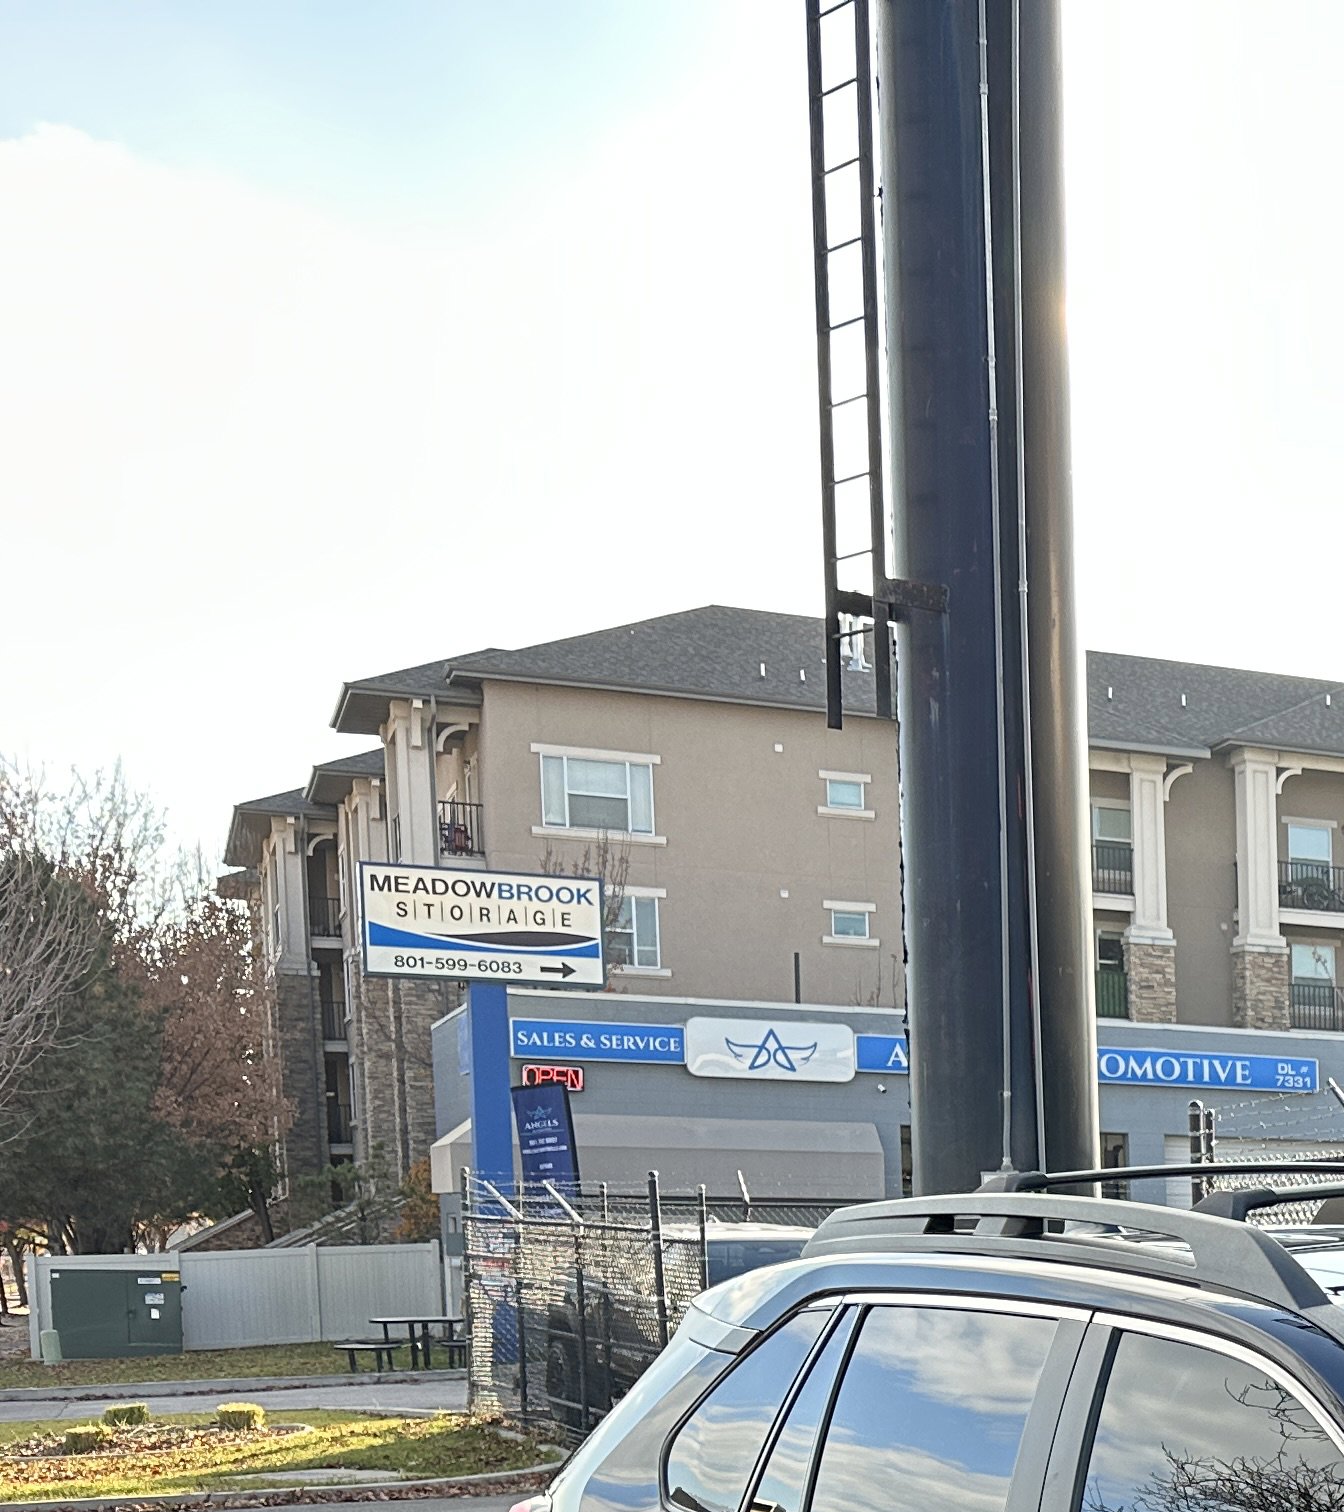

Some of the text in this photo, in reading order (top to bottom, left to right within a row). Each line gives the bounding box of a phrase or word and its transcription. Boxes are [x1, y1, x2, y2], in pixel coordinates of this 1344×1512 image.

[369, 873, 595, 906] MEADOWBROOK
[394, 954, 523, 975] 801-599-6083
[517, 1030, 681, 1052] SALES & SERVICE
[524, 1066, 583, 1089] OPEN
[1097, 1053, 1252, 1085] OMOTIVE
[1277, 1062, 1297, 1076] DL
[1275, 1075, 1312, 1089] 7331
